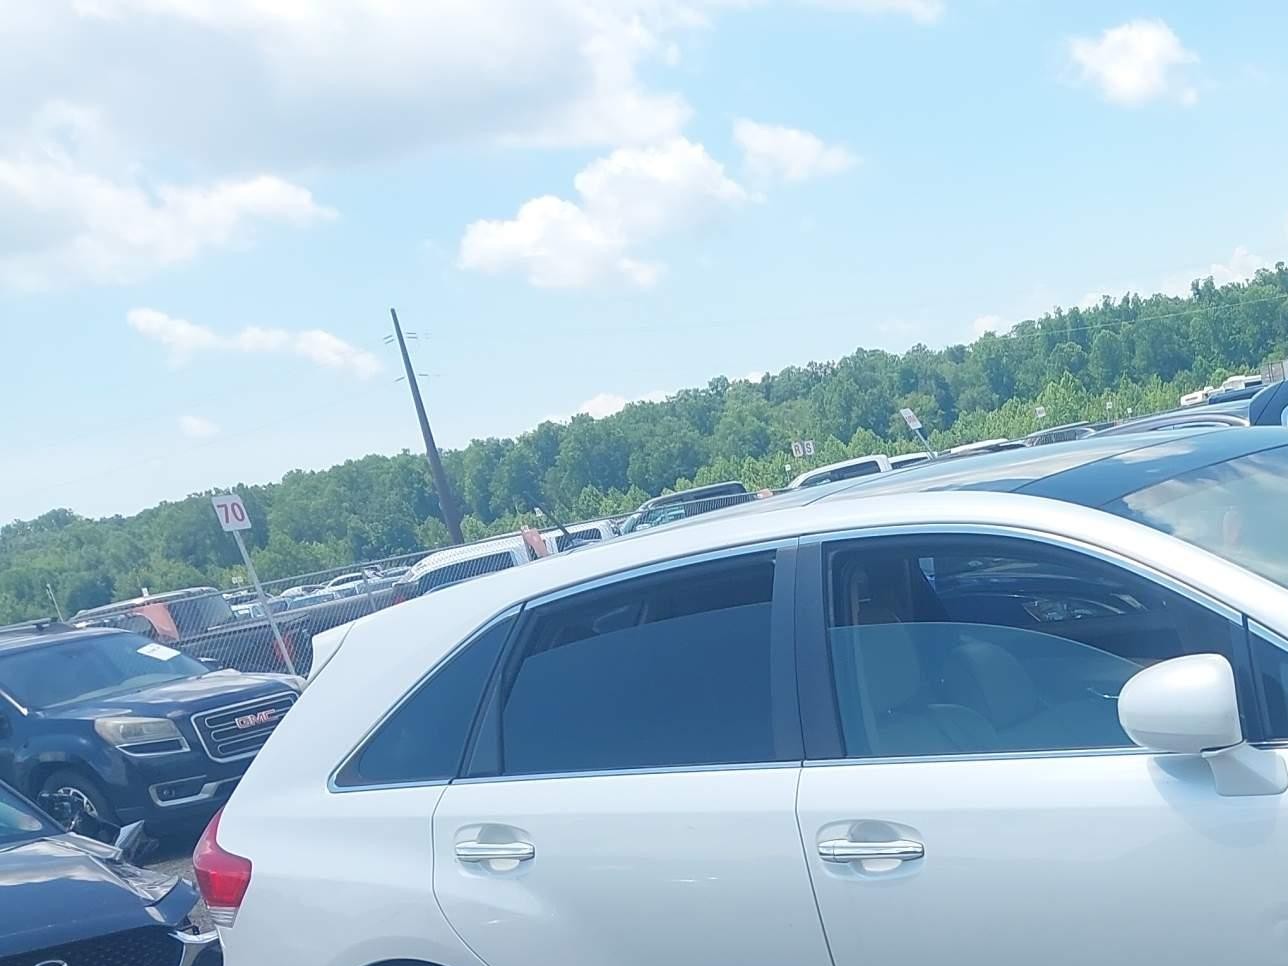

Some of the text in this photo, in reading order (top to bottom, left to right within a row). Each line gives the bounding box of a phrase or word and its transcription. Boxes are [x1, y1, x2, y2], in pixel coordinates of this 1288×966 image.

[805, 442, 812, 454] S
[216, 502, 246, 524] 70
[235, 709, 276, 728] GMC
